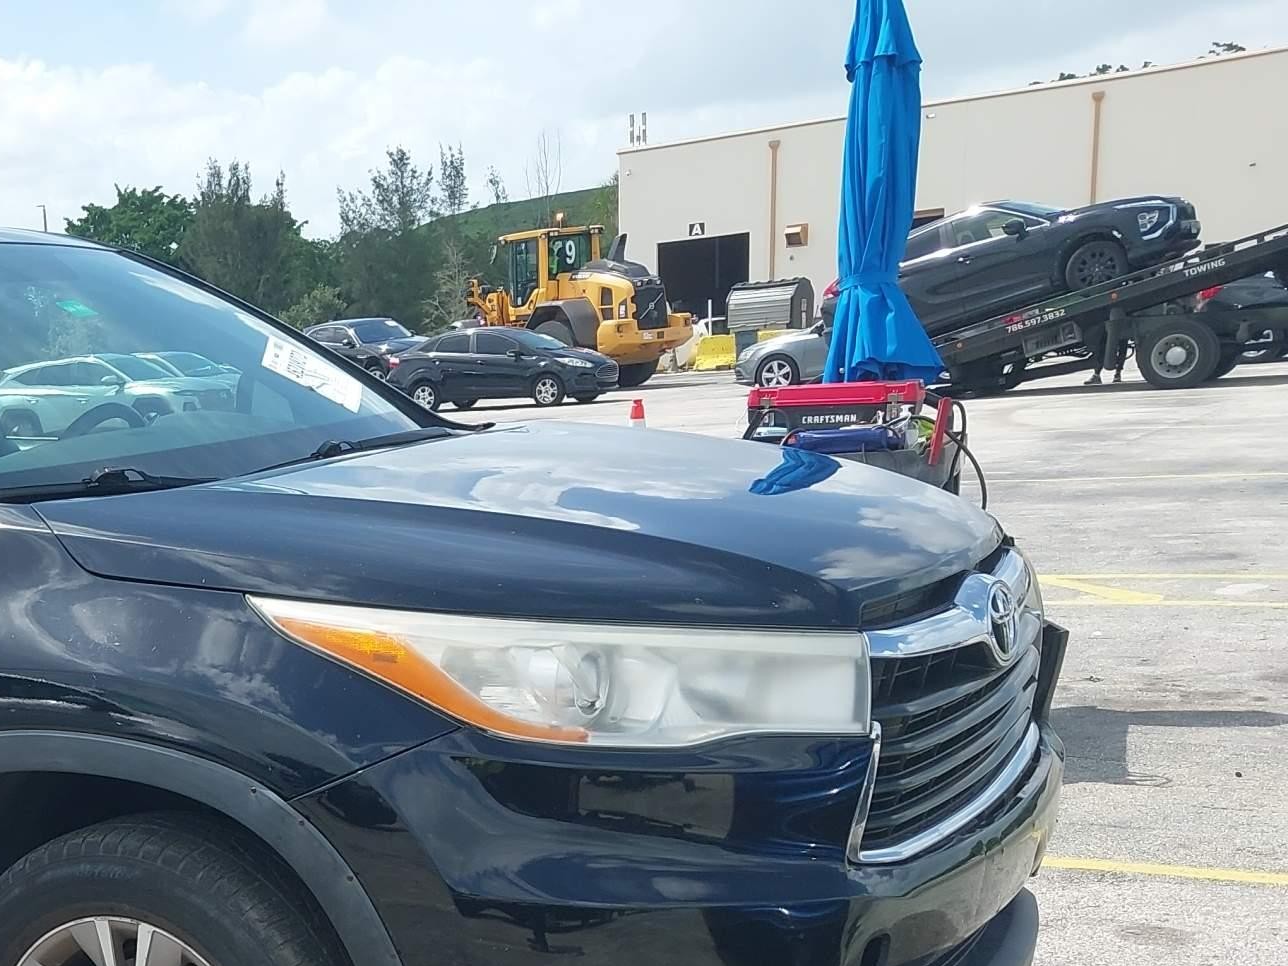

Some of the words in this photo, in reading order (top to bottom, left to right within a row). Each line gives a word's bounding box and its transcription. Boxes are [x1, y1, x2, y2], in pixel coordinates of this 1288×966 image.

[691, 223, 702, 235] A
[565, 240, 576, 264] 9
[1183, 258, 1226, 277] TOWING
[802, 414, 857, 424] CRAFTSMAN
